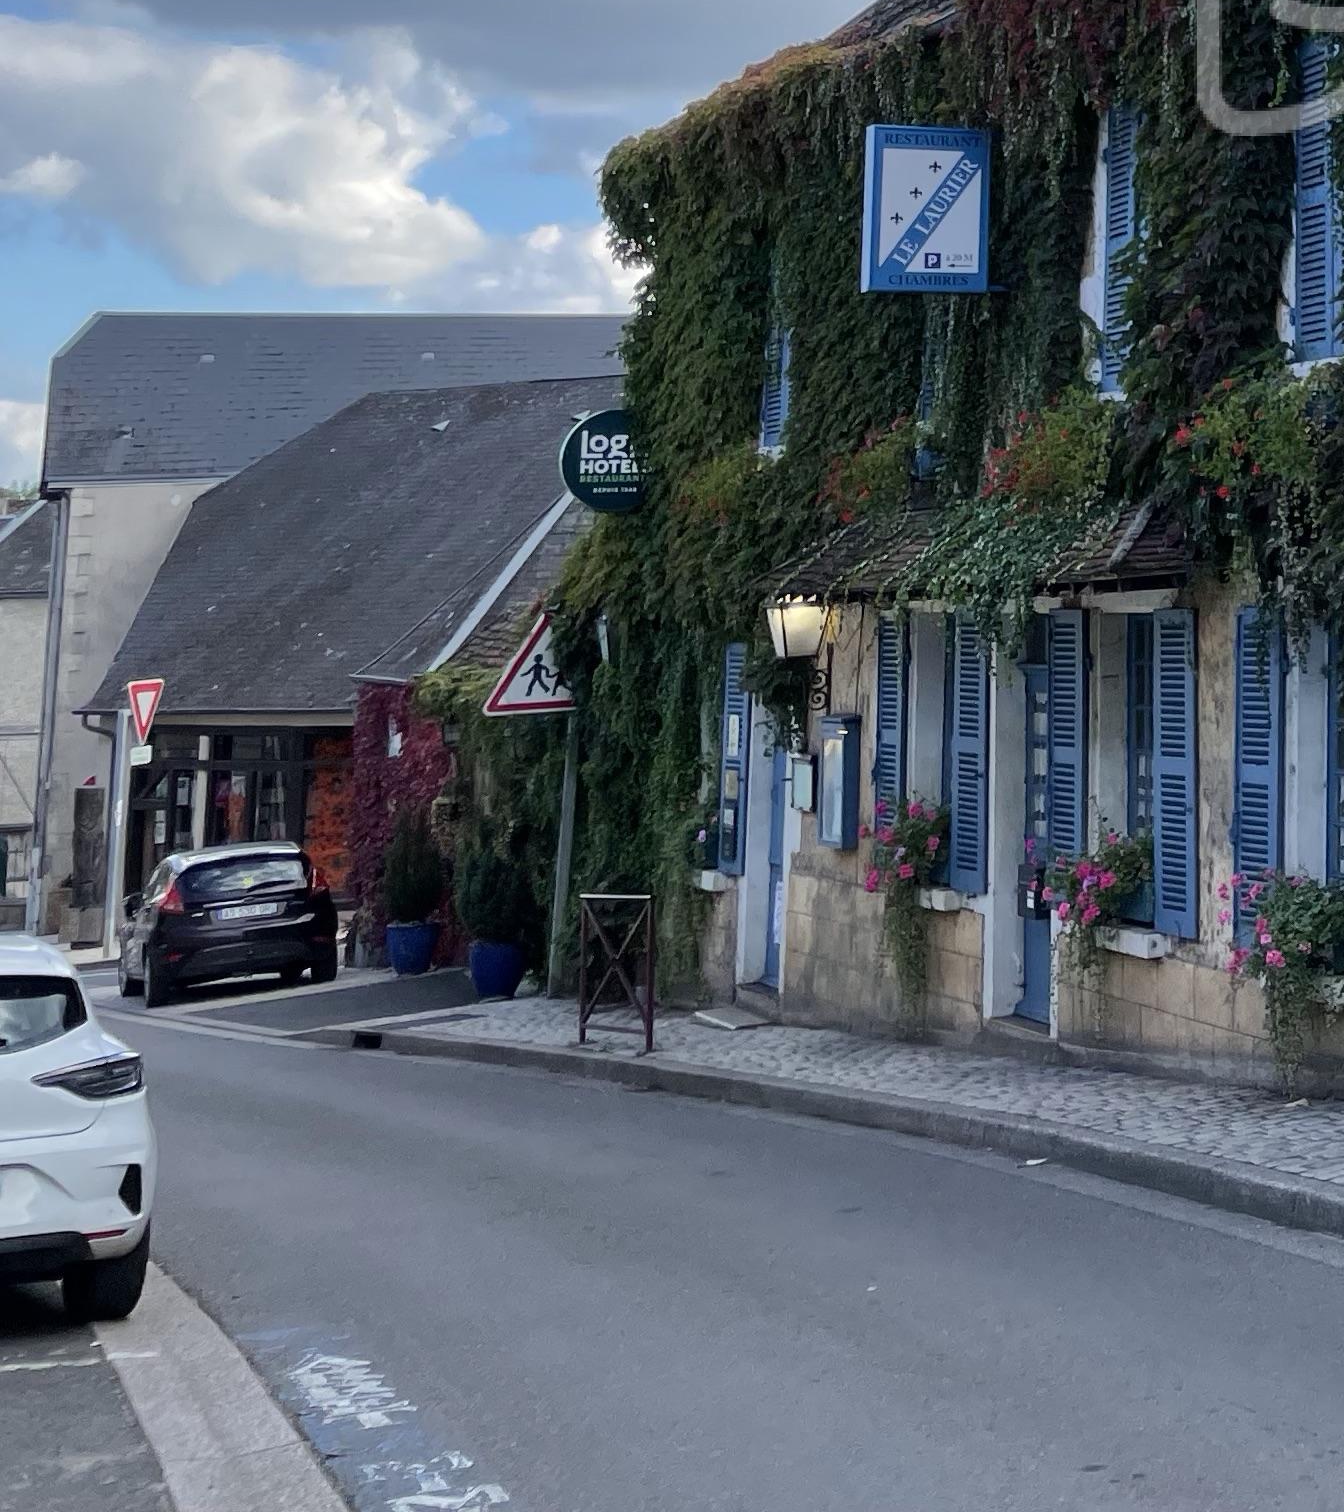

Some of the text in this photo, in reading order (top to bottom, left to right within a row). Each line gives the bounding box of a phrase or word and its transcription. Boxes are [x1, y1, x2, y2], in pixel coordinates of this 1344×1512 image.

[884, 133, 982, 147] RESTAURANT
[892, 157, 979, 267] LE LAURIER
[888, 274, 969, 286] CHAMBRES
